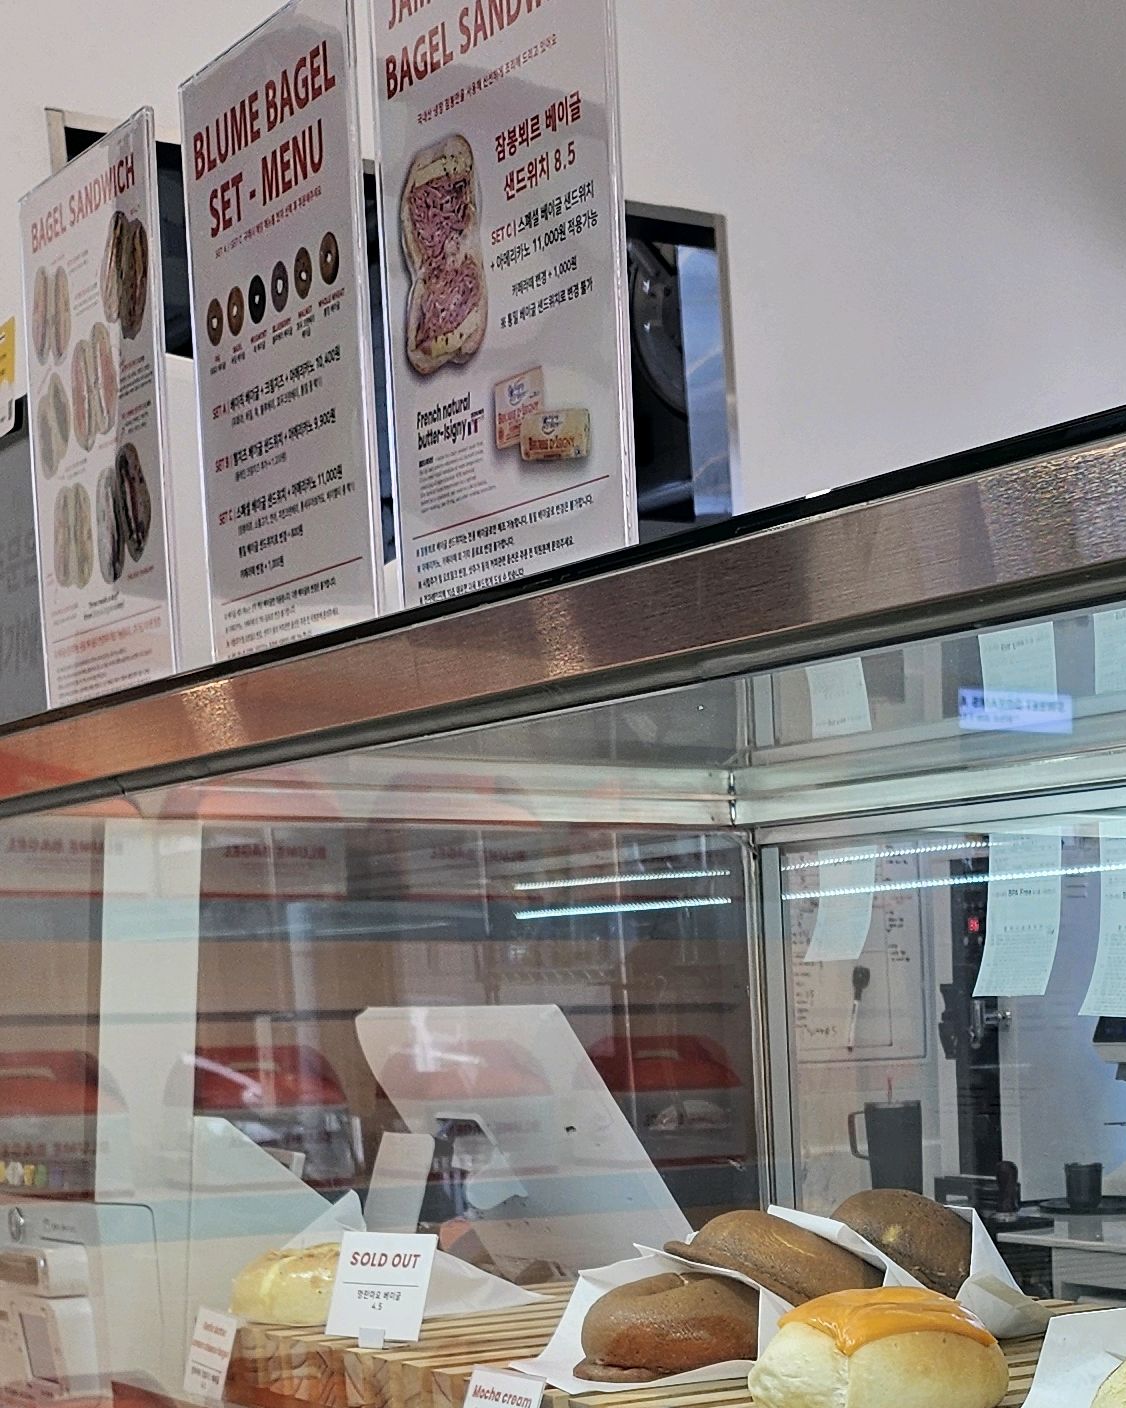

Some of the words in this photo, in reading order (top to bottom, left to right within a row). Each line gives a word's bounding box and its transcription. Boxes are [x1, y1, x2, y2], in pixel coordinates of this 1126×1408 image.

[386, 22, 453, 99] BAGEL
[194, 90, 261, 181] BLUME
[265, 40, 336, 133] BAGEL
[494, 111, 541, 165] 잠봉뵈르
[544, 88, 582, 138] 베이글
[31, 204, 66, 254] BAGEL
[70, 152, 135, 227] SANDWICH
[210, 172, 243, 238] SET
[262, 118, 324, 207] MENU
[503, 151, 549, 203] 샌드위치
[553, 139, 575, 175] 8.5
[491, 225, 505, 246] SET
[506, 221, 512, 238] C
[517, 207, 539, 235] 스페셜
[540, 195, 562, 223] 베이글
[563, 179, 594, 212] 샌드위치
[496, 240, 530, 272] 아메리카노
[532, 222, 566, 255] 11,000원
[567, 205, 598, 239] 적용가능
[415, 402, 441, 431] French
[442, 391, 470, 420] natural
[350, 1252, 388, 1267] SOLD
[392, 1254, 421, 1268] OUT
[472, 1385, 501, 1402] Mocha
[502, 1393, 532, 1408] cream
